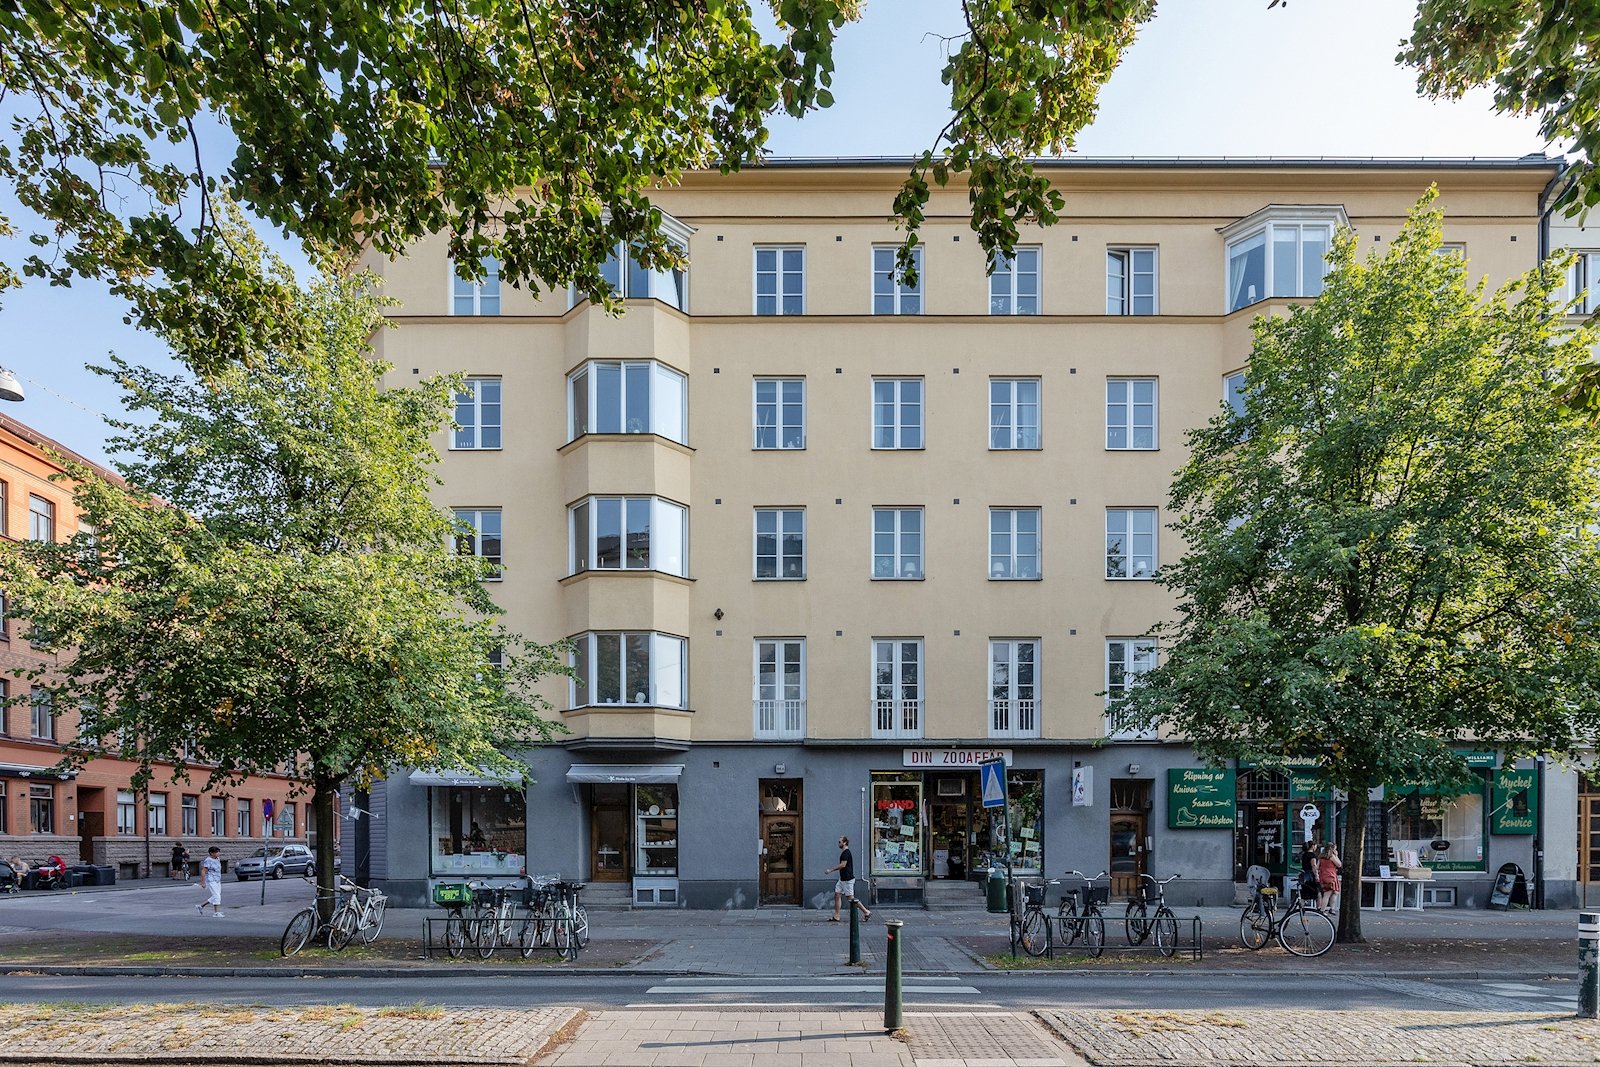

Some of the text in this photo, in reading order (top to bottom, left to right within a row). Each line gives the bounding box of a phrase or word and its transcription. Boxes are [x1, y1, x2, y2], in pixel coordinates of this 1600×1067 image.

[911, 751, 933, 764] DIN
[1183, 770, 1213, 782] Slipning
[1499, 774, 1533, 788] Nyckel
[1173, 783, 1198, 793] Knivar
[877, 799, 915, 810] HUND
[1192, 797, 1213, 807] Saxar
[1198, 814, 1233, 825] Skridskor
[1499, 815, 1533, 829] Service
